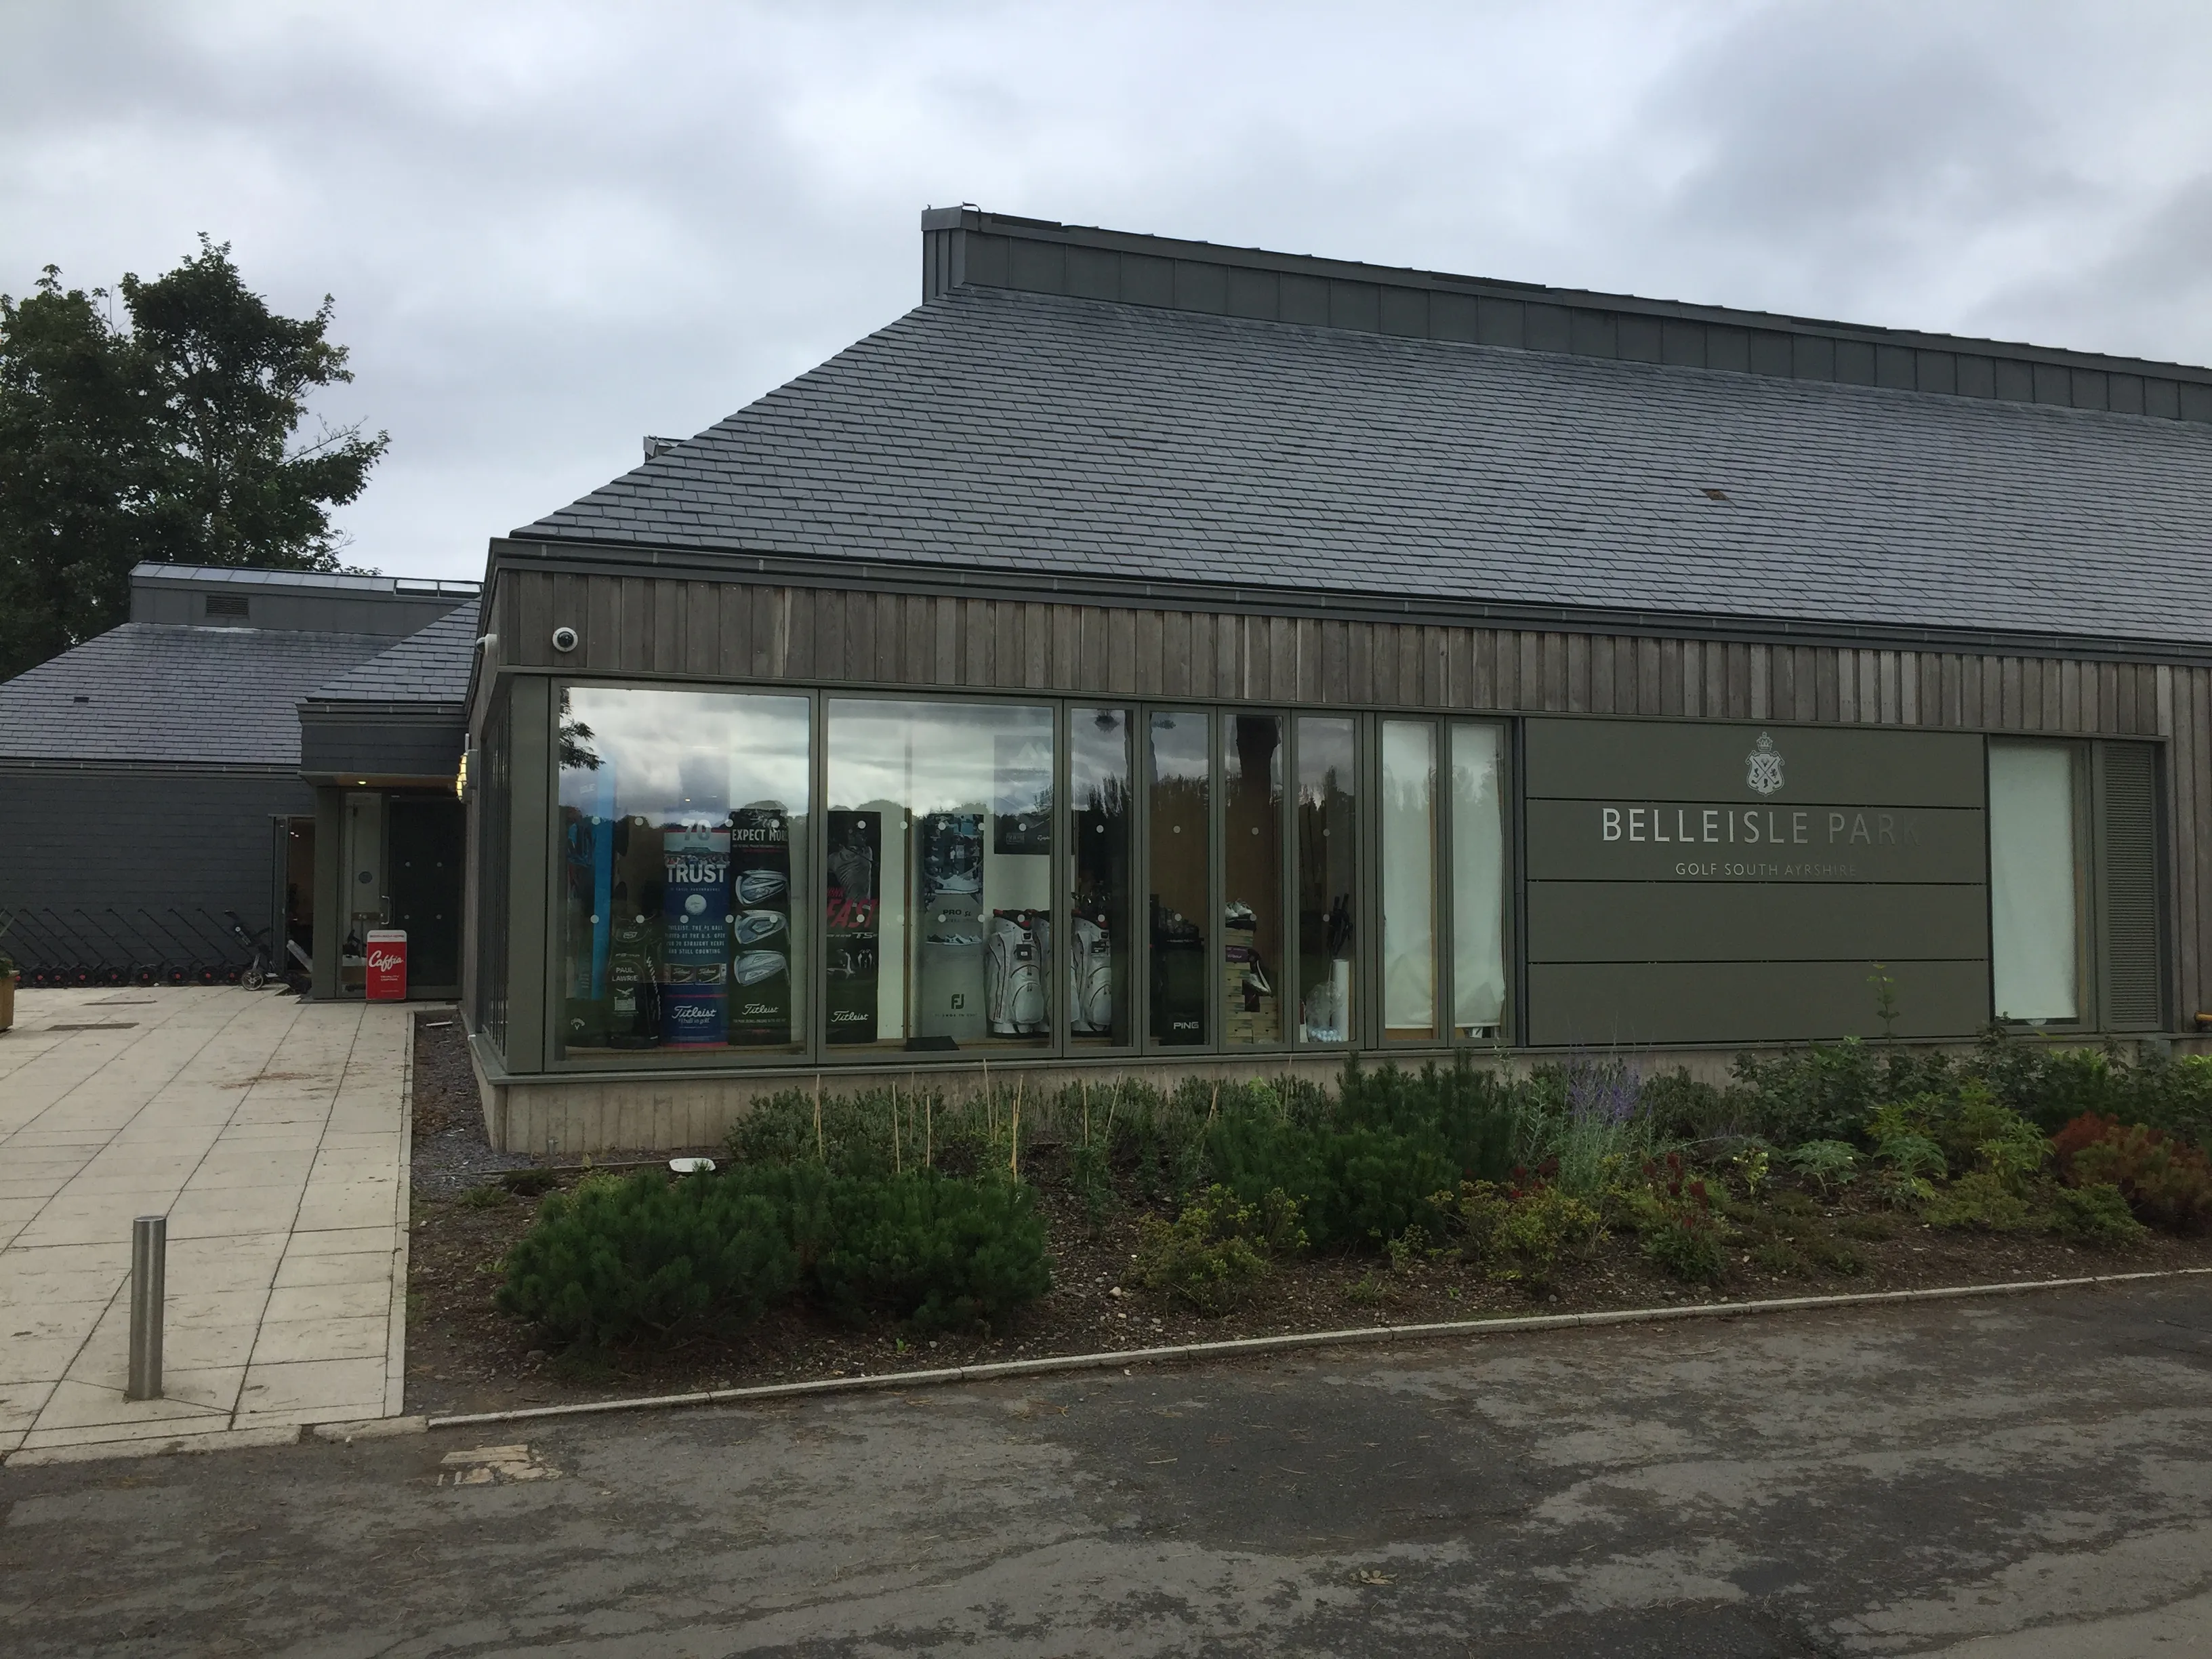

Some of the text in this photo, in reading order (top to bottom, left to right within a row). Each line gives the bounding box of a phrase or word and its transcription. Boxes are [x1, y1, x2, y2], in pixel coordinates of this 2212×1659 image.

[681, 819, 712, 840] 70
[1602, 807, 1921, 846] BELLEISLE PARK
[732, 829, 766, 841] EXPECT
[666, 863, 726, 883] TRUST
[1675, 862, 1857, 877] GOLF SOUTH AYRSHIRE
[368, 950, 404, 972] Caffia
[741, 1003, 779, 1015] Titleist
[951, 994, 964, 1009] FJ
[672, 1005, 717, 1019] Titleist
[830, 1010, 869, 1023] Titleist
